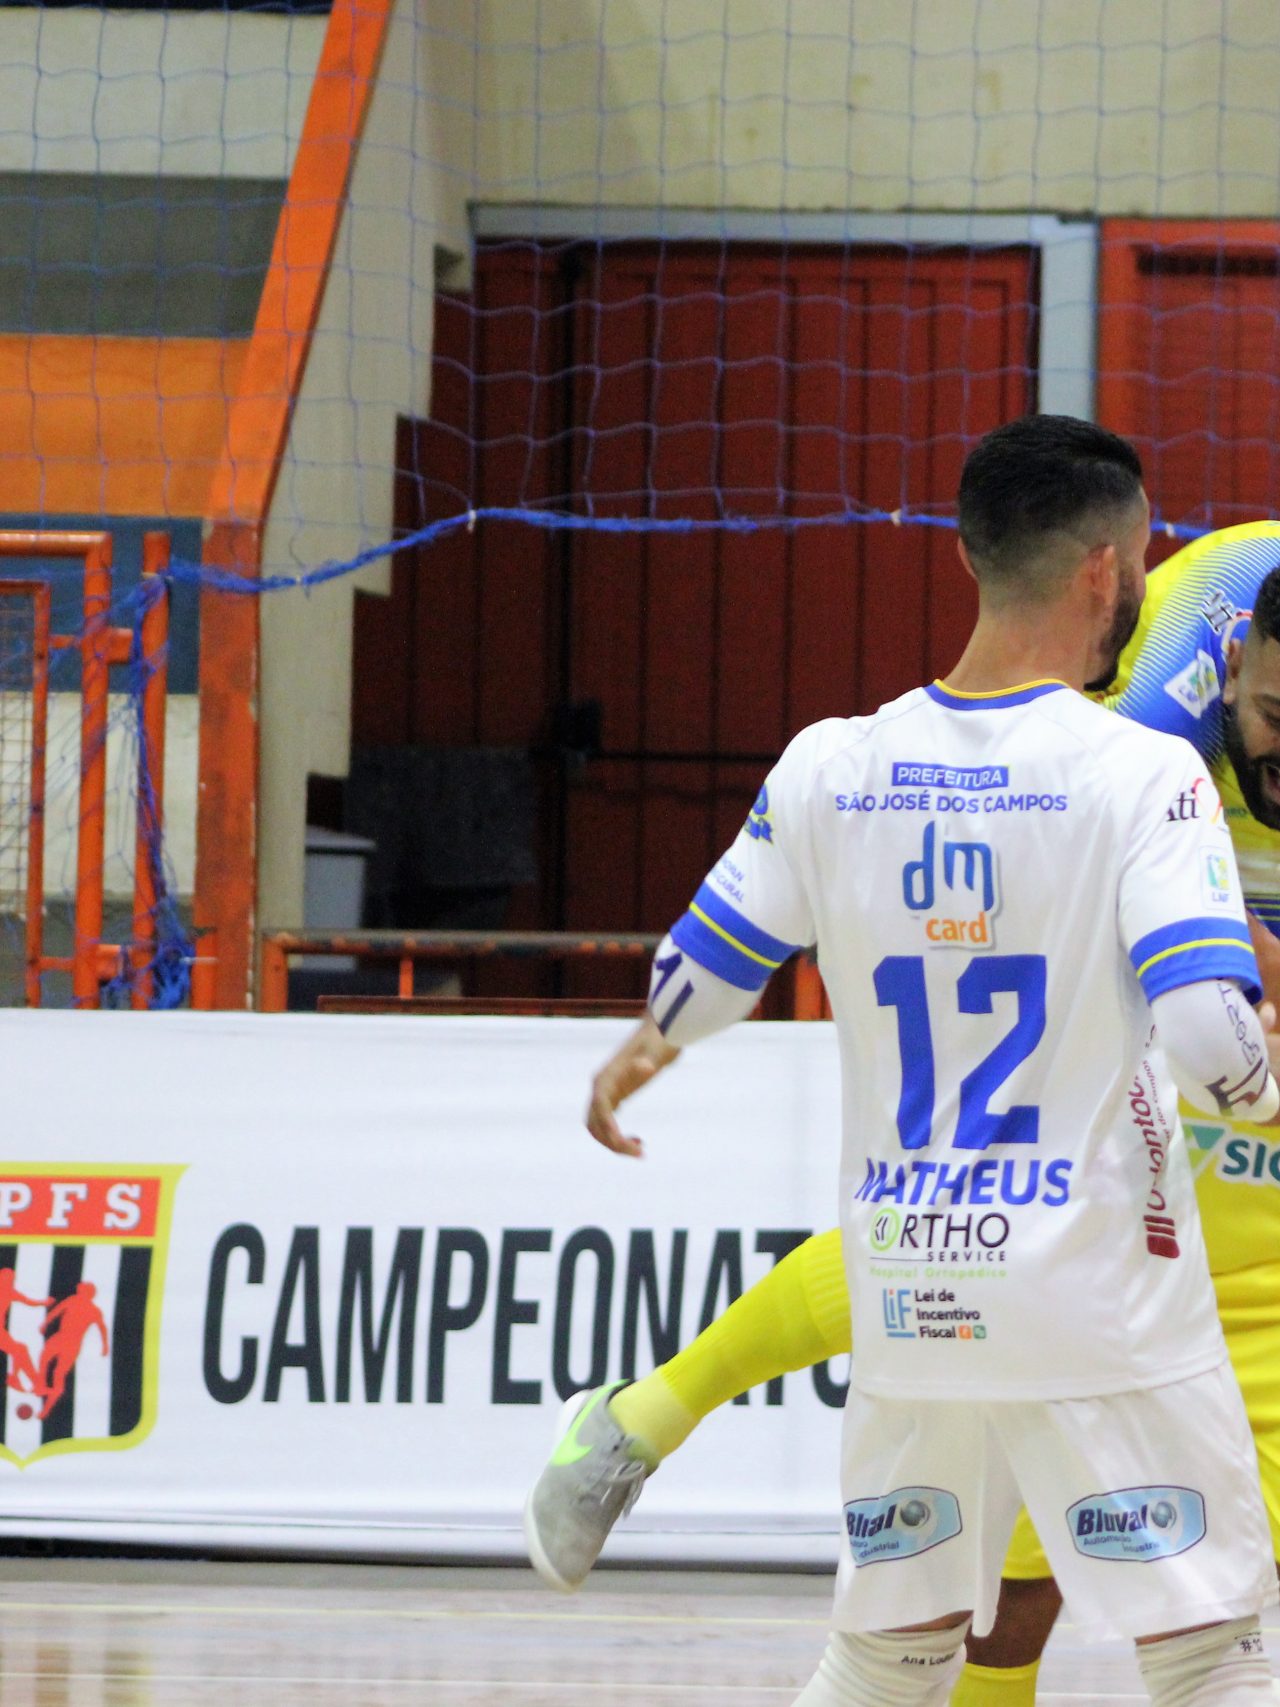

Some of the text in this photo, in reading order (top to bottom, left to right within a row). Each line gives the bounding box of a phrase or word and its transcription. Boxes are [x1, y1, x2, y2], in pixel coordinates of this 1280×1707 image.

[898, 766, 1003, 788] PREFEITURA
[835, 790, 1068, 814] SÃO JOSÉ DOS CAMPOS
[902, 820, 994, 911] dm
[926, 912, 988, 944] card
[873, 954, 1047, 1150] 12
[854, 1158, 1074, 1207] MATHEUS
[927, 1250, 1006, 1262] SERVICE
[914, 1288, 955, 1302] Lei de
[916, 1307, 981, 1321] Incentivo
[919, 1325, 957, 1338] Fiscal
[1076, 1503, 1149, 1537] Bluval
